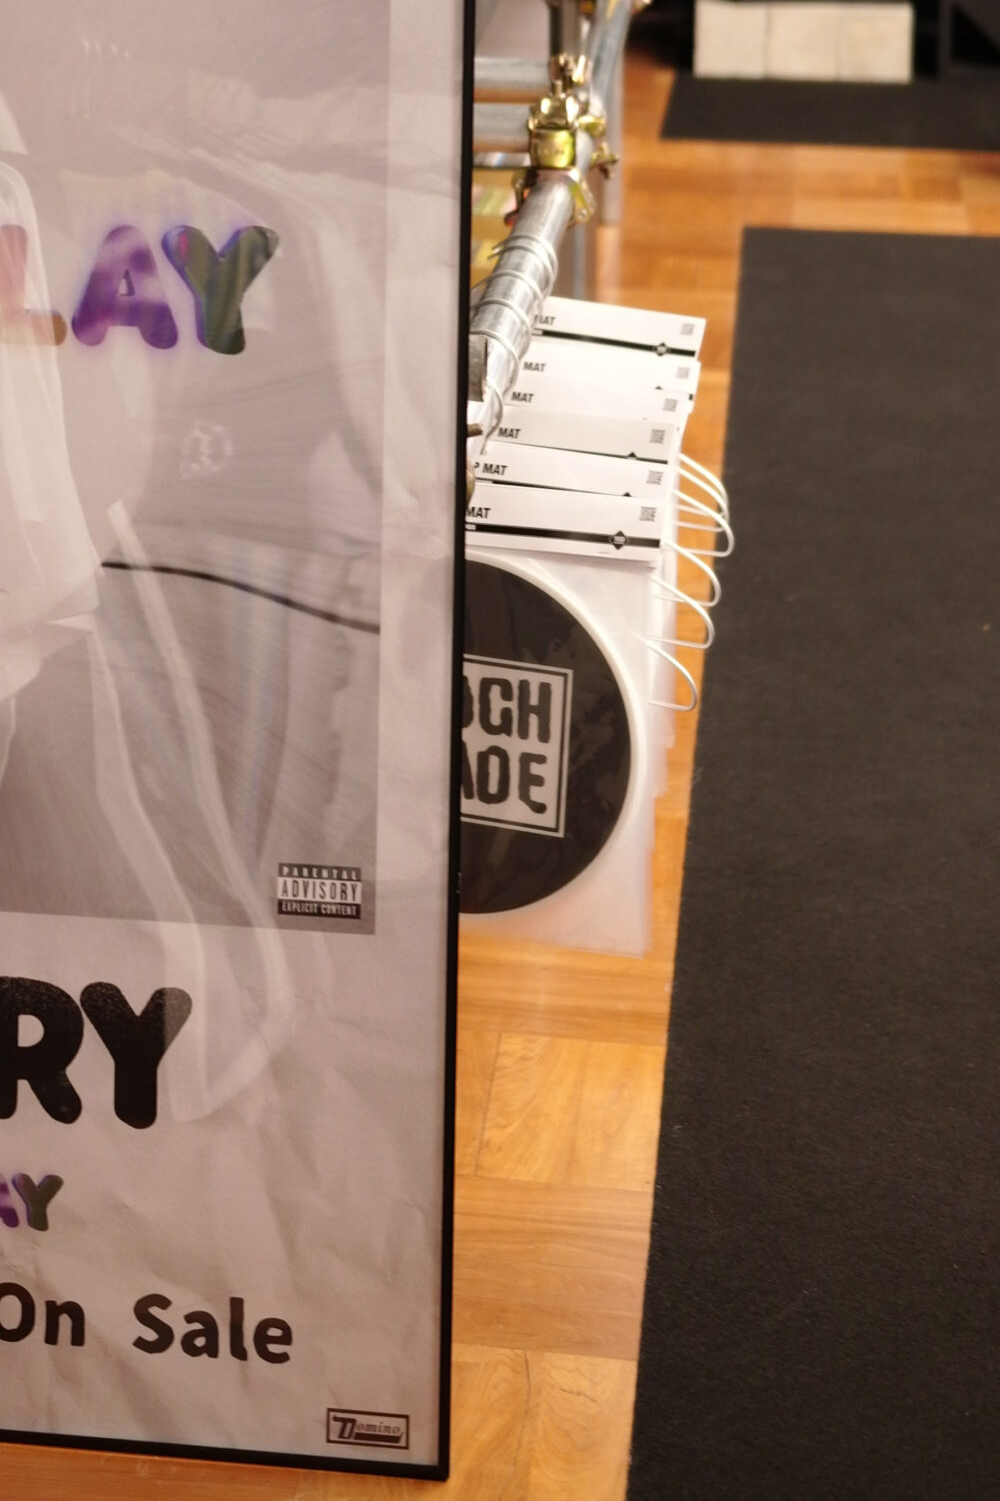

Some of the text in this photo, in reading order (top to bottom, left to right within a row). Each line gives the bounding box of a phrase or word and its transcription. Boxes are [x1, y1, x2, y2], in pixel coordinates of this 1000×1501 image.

[523, 361, 547, 373] MAT
[510, 391, 535, 404] MAT
[497, 427, 521, 439] MAT
[482, 462, 508, 476] MAT
[281, 866, 358, 881] PARENTAL
[281, 879, 358, 902] ADVISORY
[281, 901, 357, 917] EXPLICIT CONTENT
[132, 1292, 294, 1365] Sale
[332, 1414, 404, 1440] Domino
